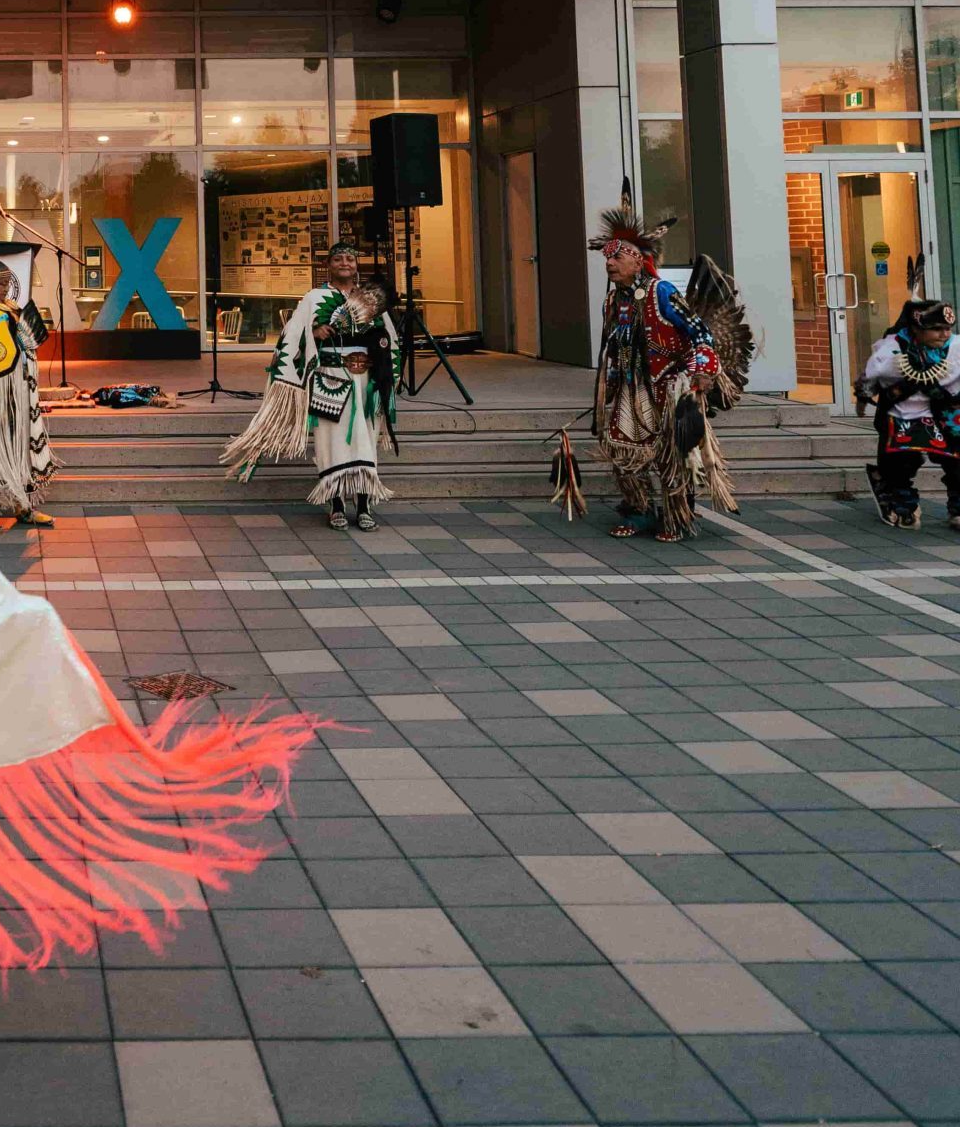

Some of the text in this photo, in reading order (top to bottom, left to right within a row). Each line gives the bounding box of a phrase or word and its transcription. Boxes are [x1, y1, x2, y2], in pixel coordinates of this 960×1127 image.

[231, 193, 325, 208] HISTORY OF AJAX
